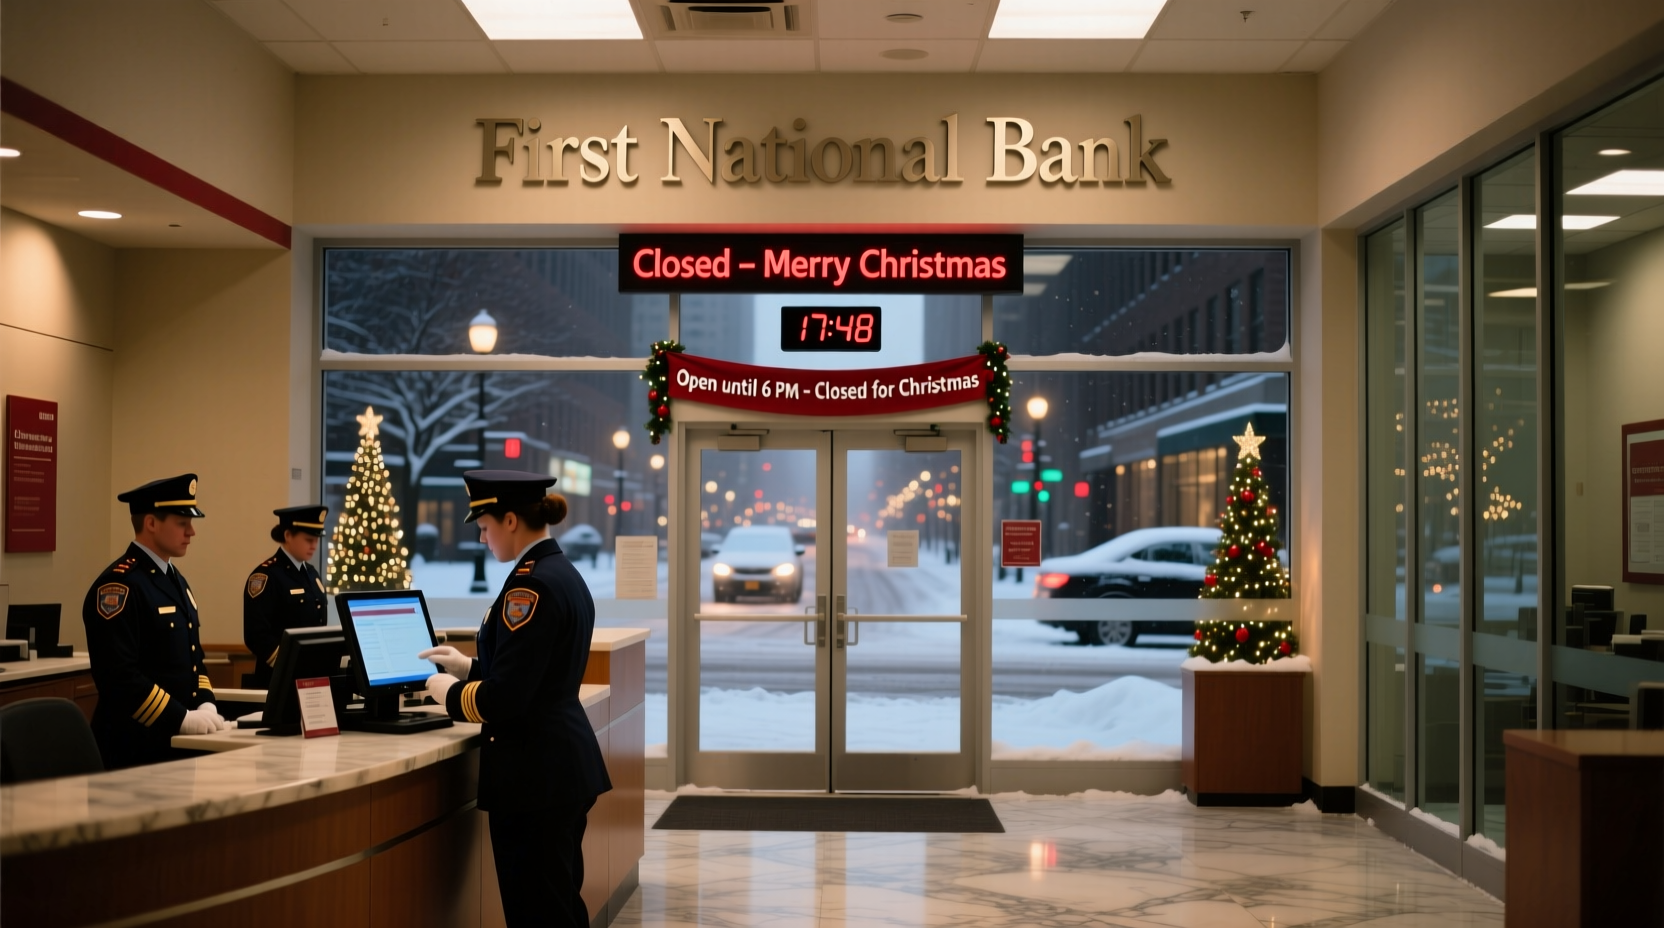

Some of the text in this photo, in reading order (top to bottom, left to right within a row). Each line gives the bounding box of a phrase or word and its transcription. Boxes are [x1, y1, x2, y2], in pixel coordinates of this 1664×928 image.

[474, 113, 1172, 184] First National Bank
[632, 247, 731, 279] Closed
[763, 248, 852, 287] Merry
[859, 247, 1007, 280] Christmas
[800, 313, 874, 343] 17:48
[676, 368, 718, 393] Open
[721, 378, 758, 397] until
[761, 380, 772, 398] 6
[775, 381, 799, 400] PM
[814, 380, 867, 400] Closed
[871, 379, 895, 399] for
[898, 374, 980, 397] Christmas
